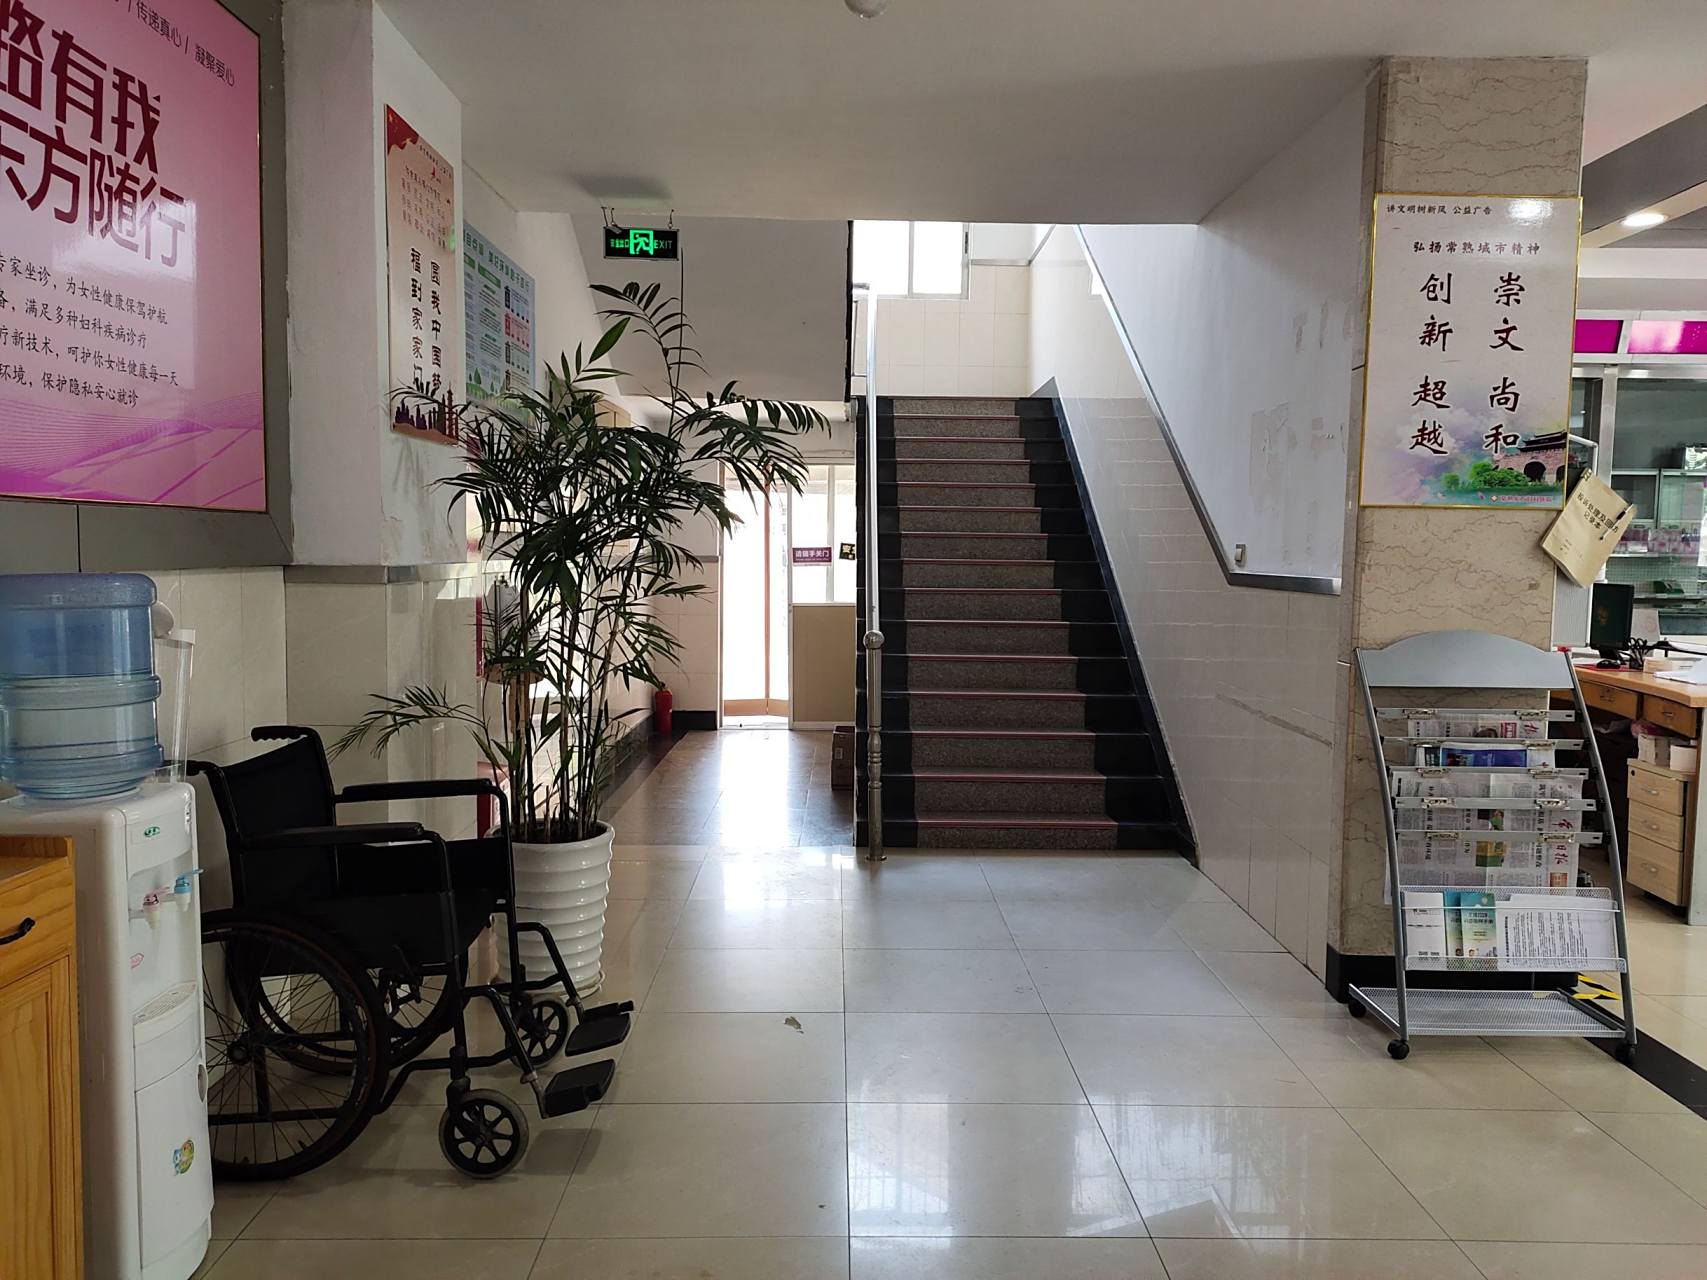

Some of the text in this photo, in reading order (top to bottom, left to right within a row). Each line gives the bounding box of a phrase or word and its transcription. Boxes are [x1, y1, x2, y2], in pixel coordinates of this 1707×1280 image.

[136, 0, 235, 88] 传递真心 凝聚爱心
[1386, 204, 1493, 215] 讲文明树新风 公益广告
[653, 239, 673, 249] EXIT
[1413, 241, 1541, 255] 弘扬常熟城市精神
[1551, 818, 1574, 866] 常日报
